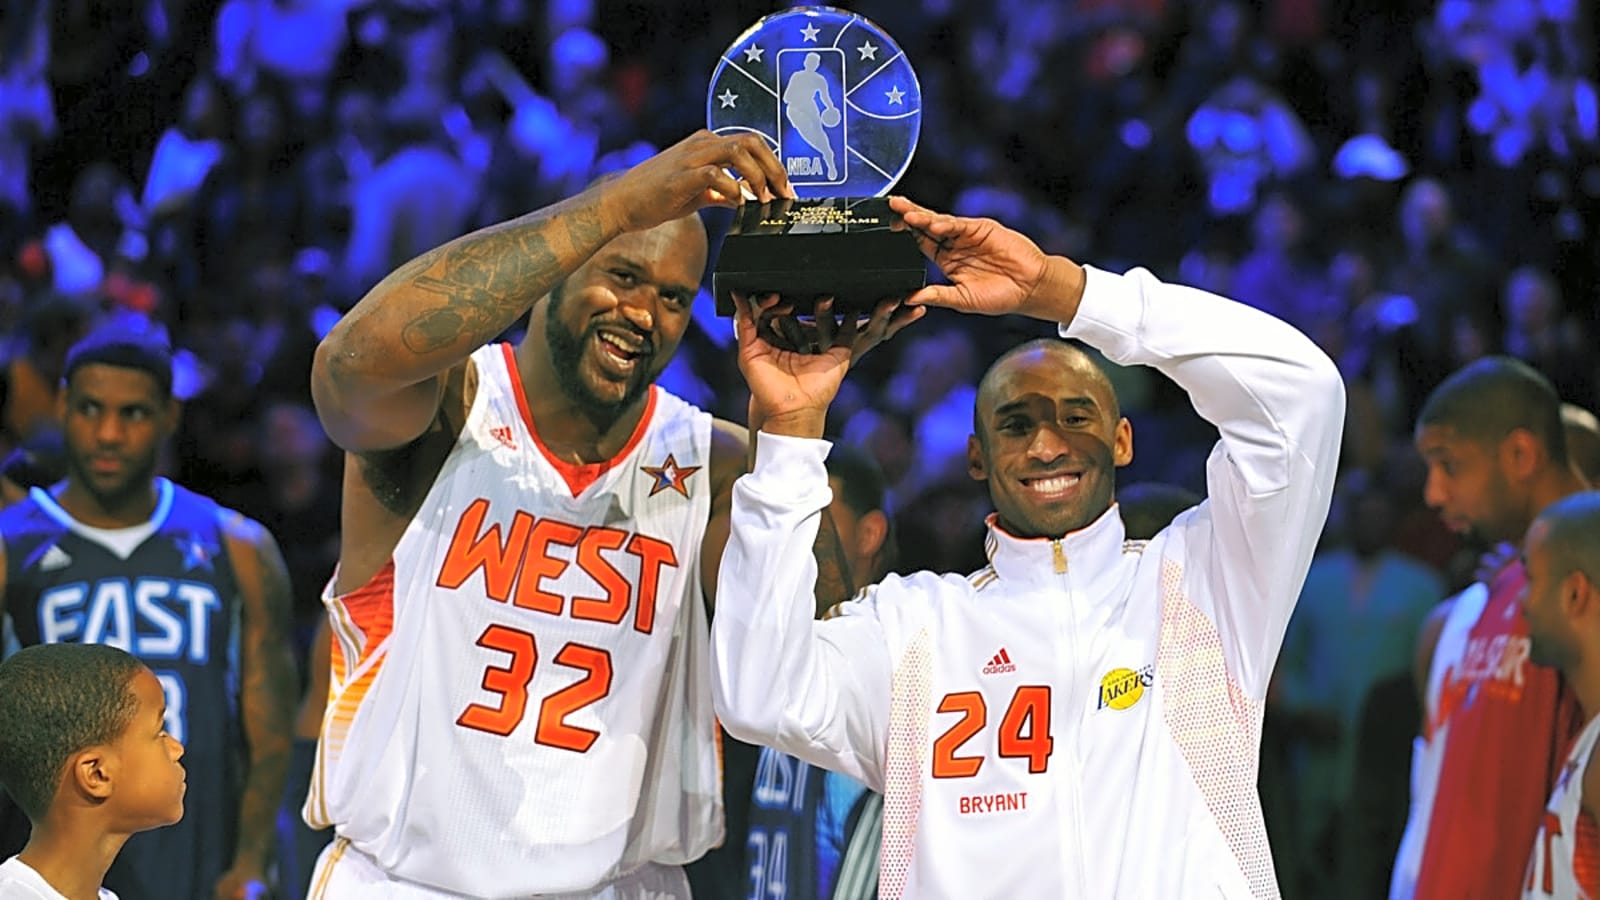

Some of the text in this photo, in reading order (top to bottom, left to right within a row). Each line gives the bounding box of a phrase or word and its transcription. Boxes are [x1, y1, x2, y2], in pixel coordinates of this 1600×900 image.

[787, 156, 824, 176] NBA
[435, 497, 680, 636] WEST
[38, 576, 222, 665] EAST
[455, 623, 614, 754] 32
[982, 663, 1017, 675] adidas
[1097, 670, 1154, 711] LAKERS
[932, 685, 1054, 779] 24
[960, 793, 1028, 814] BRYANT
